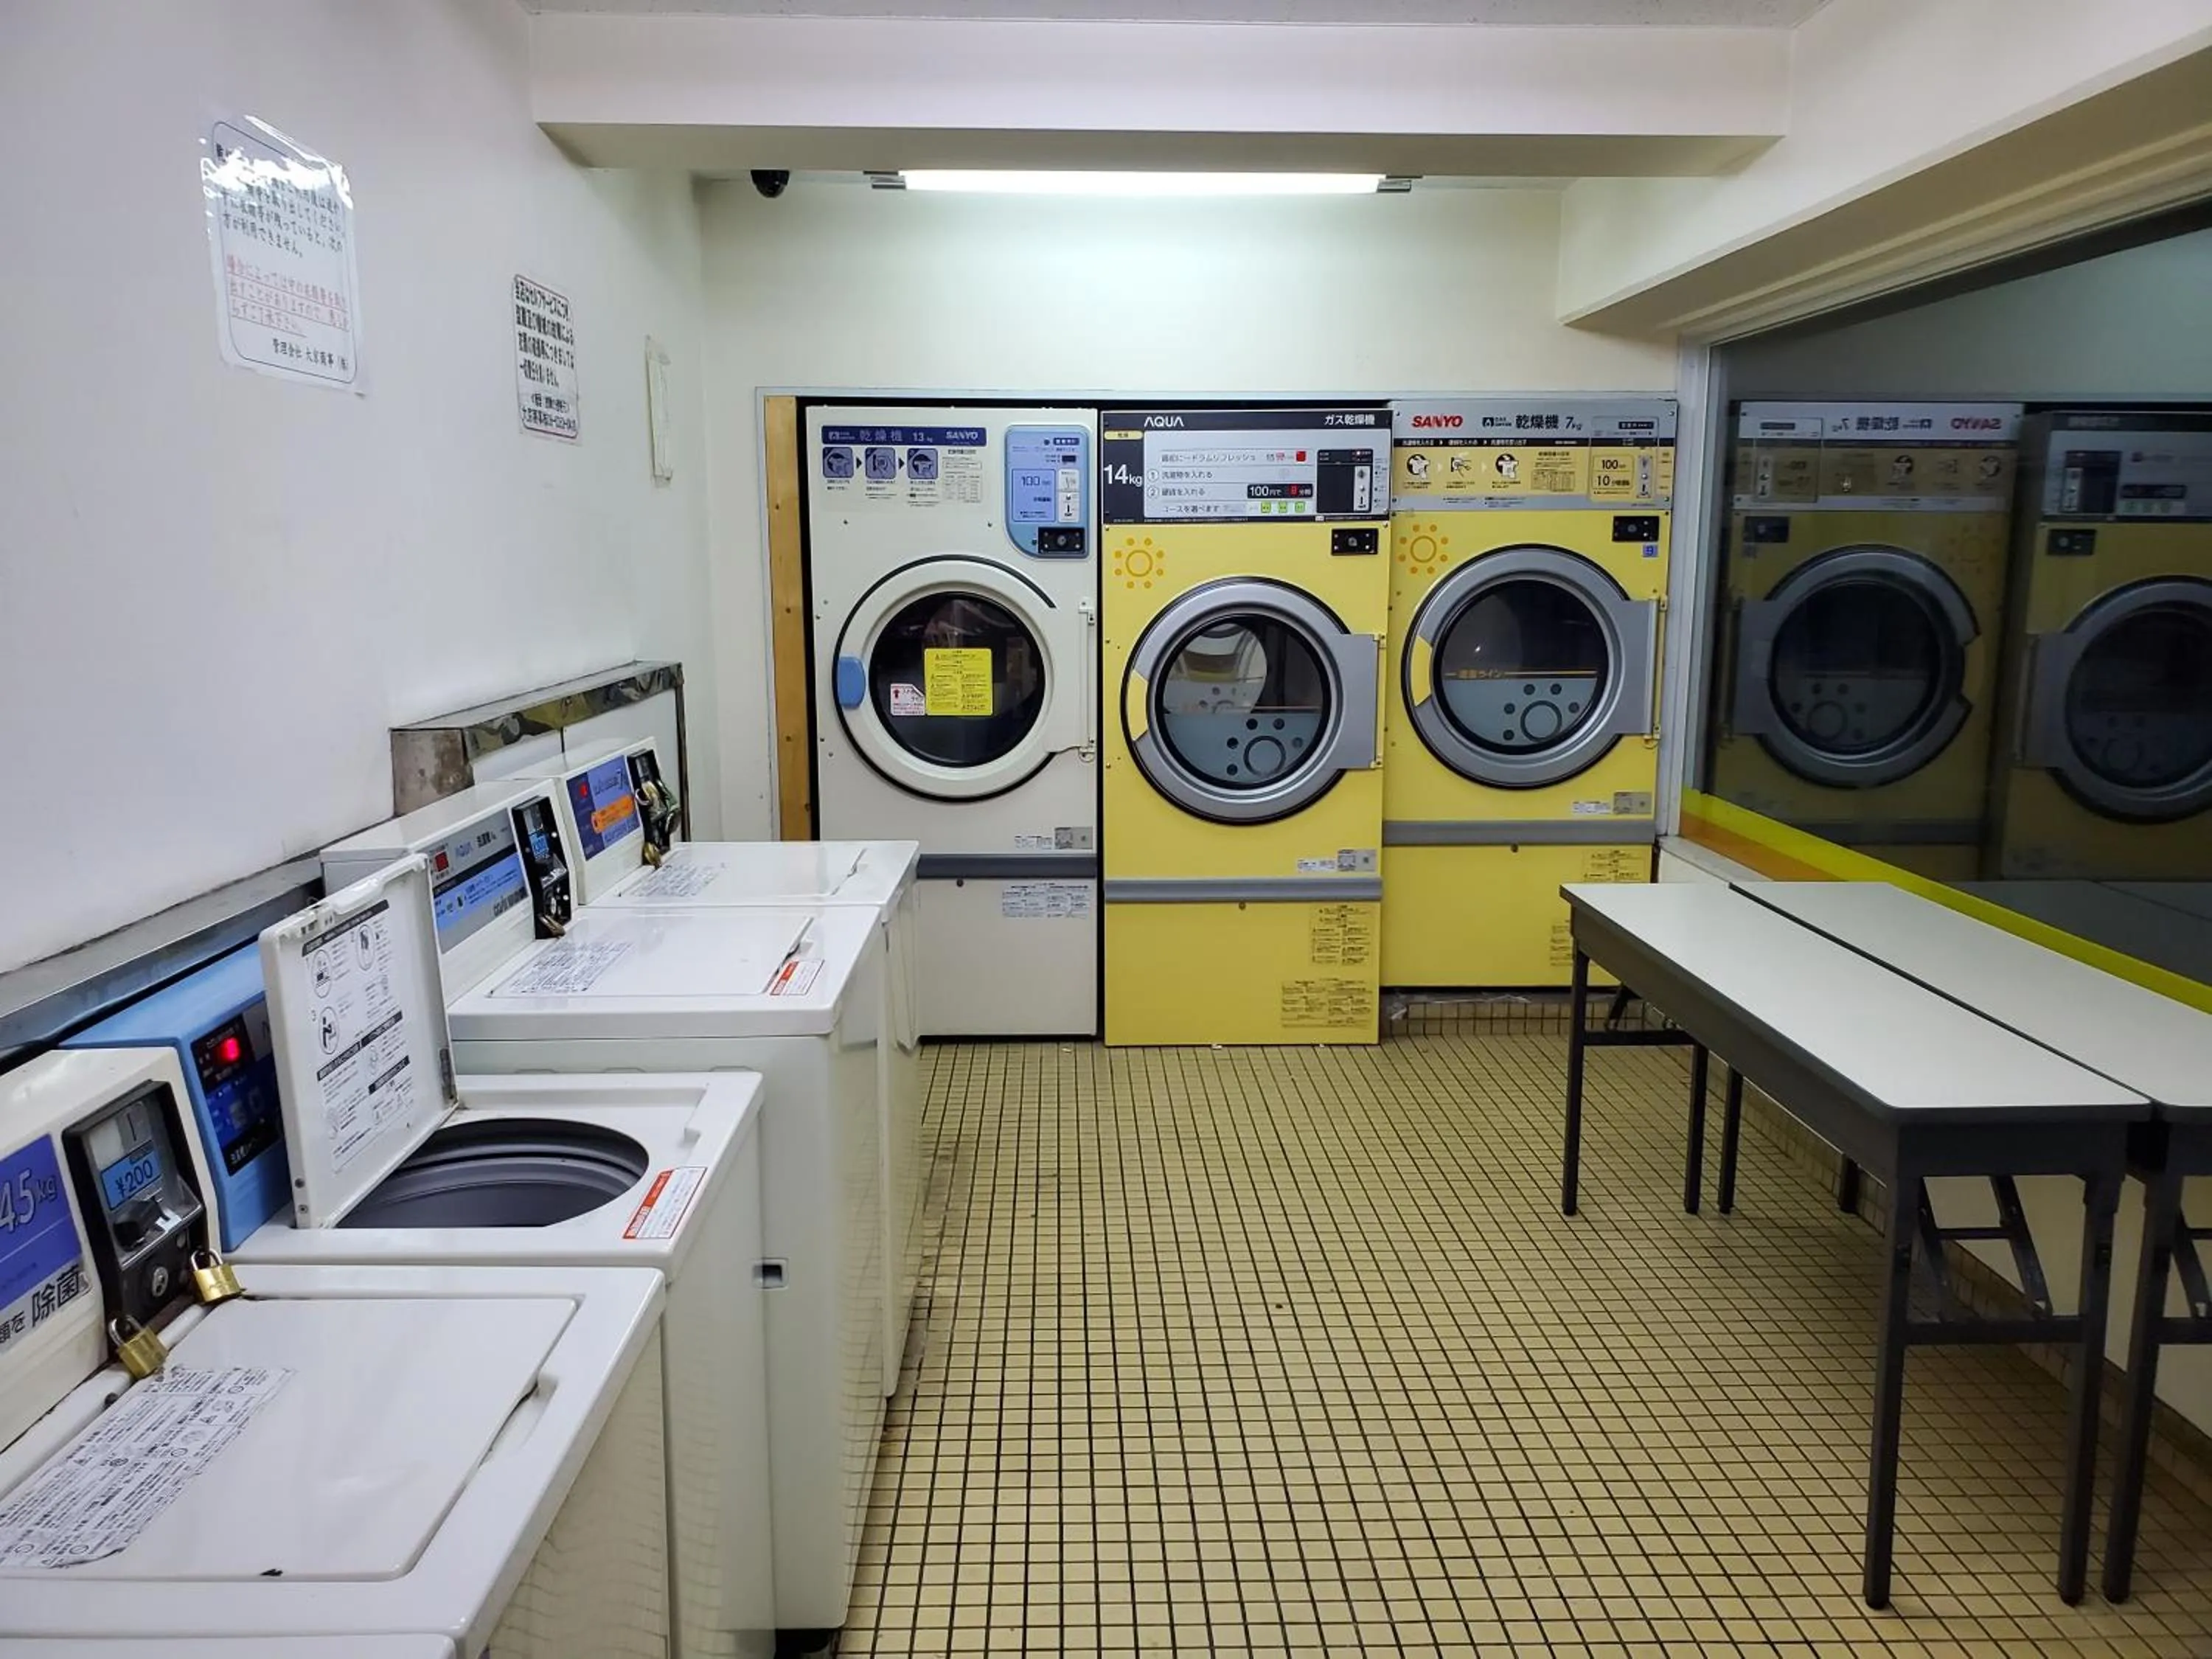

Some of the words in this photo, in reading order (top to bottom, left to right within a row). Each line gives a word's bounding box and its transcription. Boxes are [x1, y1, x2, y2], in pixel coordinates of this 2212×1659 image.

[1144, 416, 1184, 428] AQUA
[1324, 414, 1375, 425] ガス乾燥機
[1411, 415, 1464, 428] SANYO
[1515, 414, 1559, 430] 乾燥機
[945, 431, 978, 440] SANYO
[114, 1160, 154, 1197] ¥200
